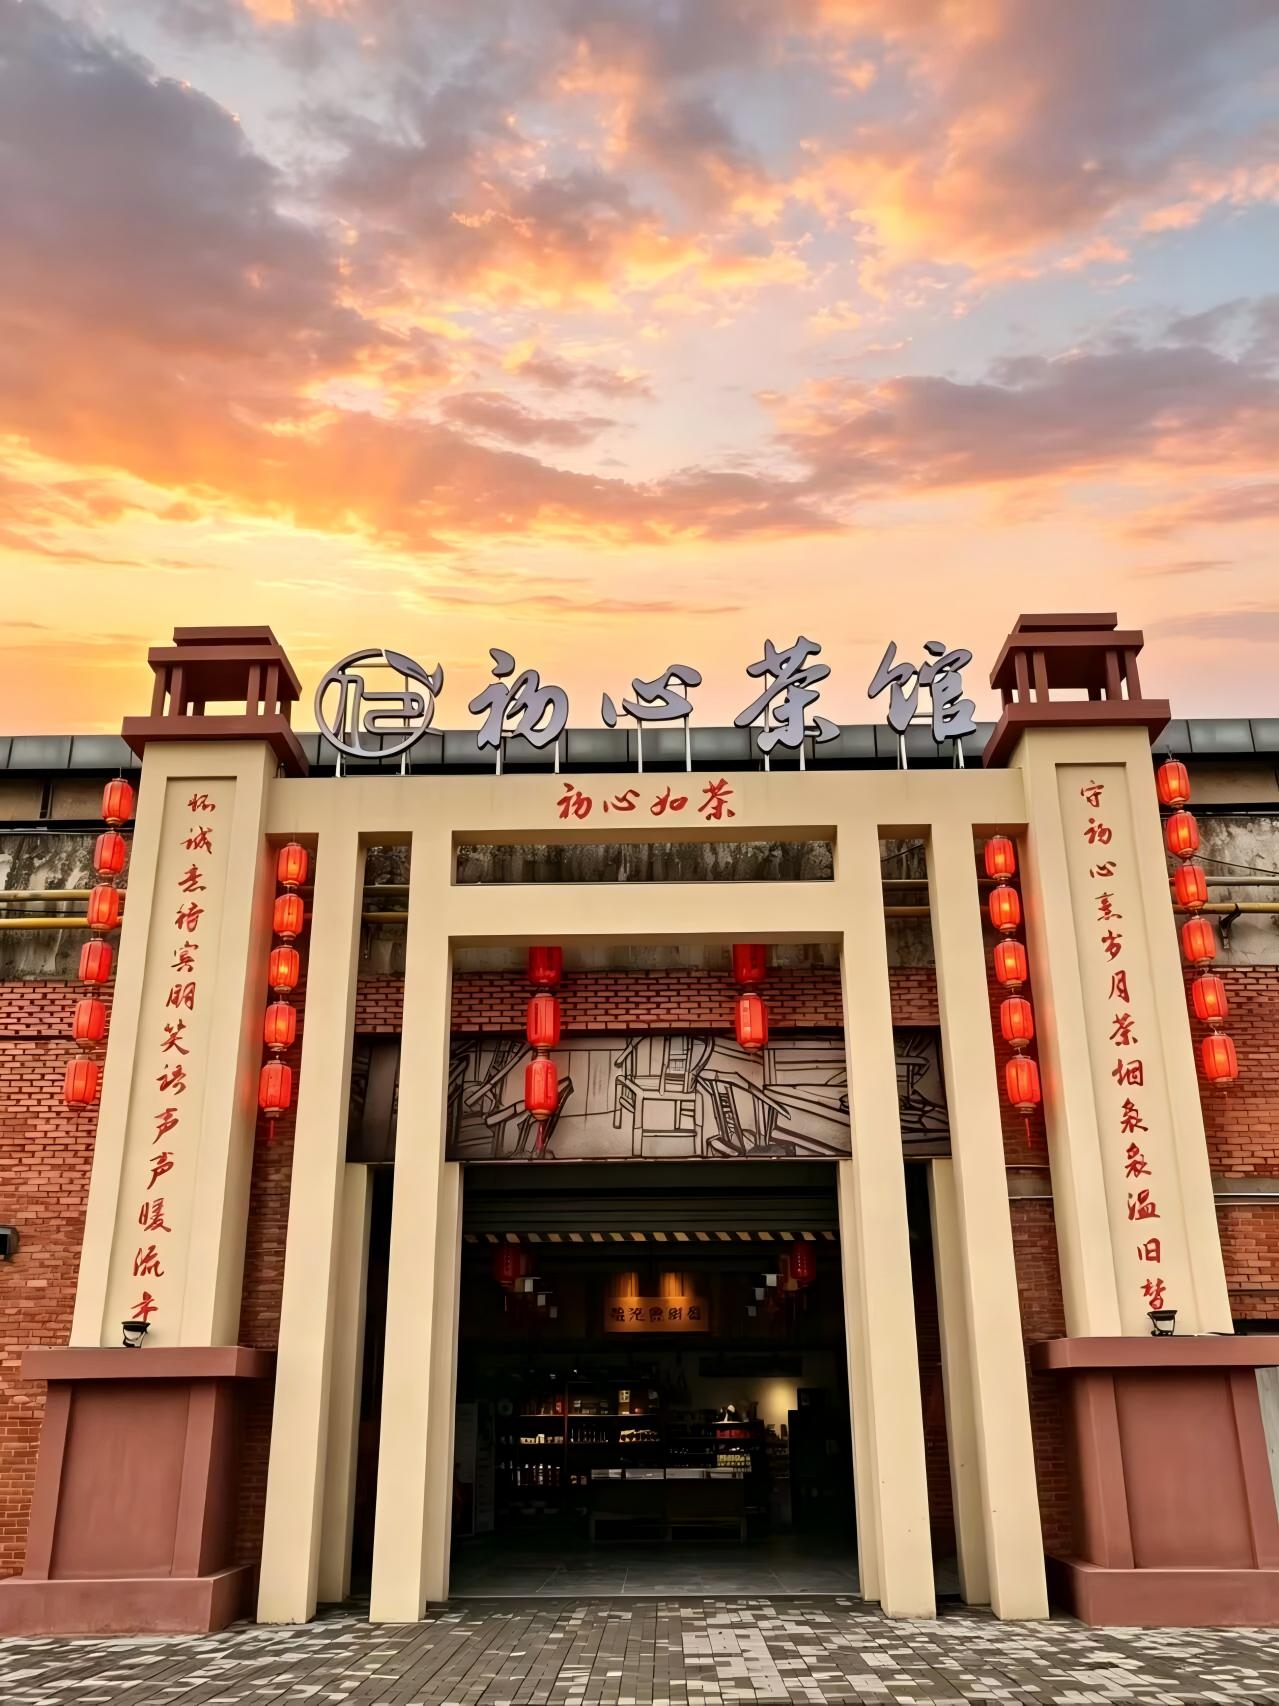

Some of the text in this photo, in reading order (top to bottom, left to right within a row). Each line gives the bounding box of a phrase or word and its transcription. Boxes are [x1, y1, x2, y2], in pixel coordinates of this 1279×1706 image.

[467, 635, 977, 754] 初心茶馆
[557, 777, 736, 821] 初心如茶
